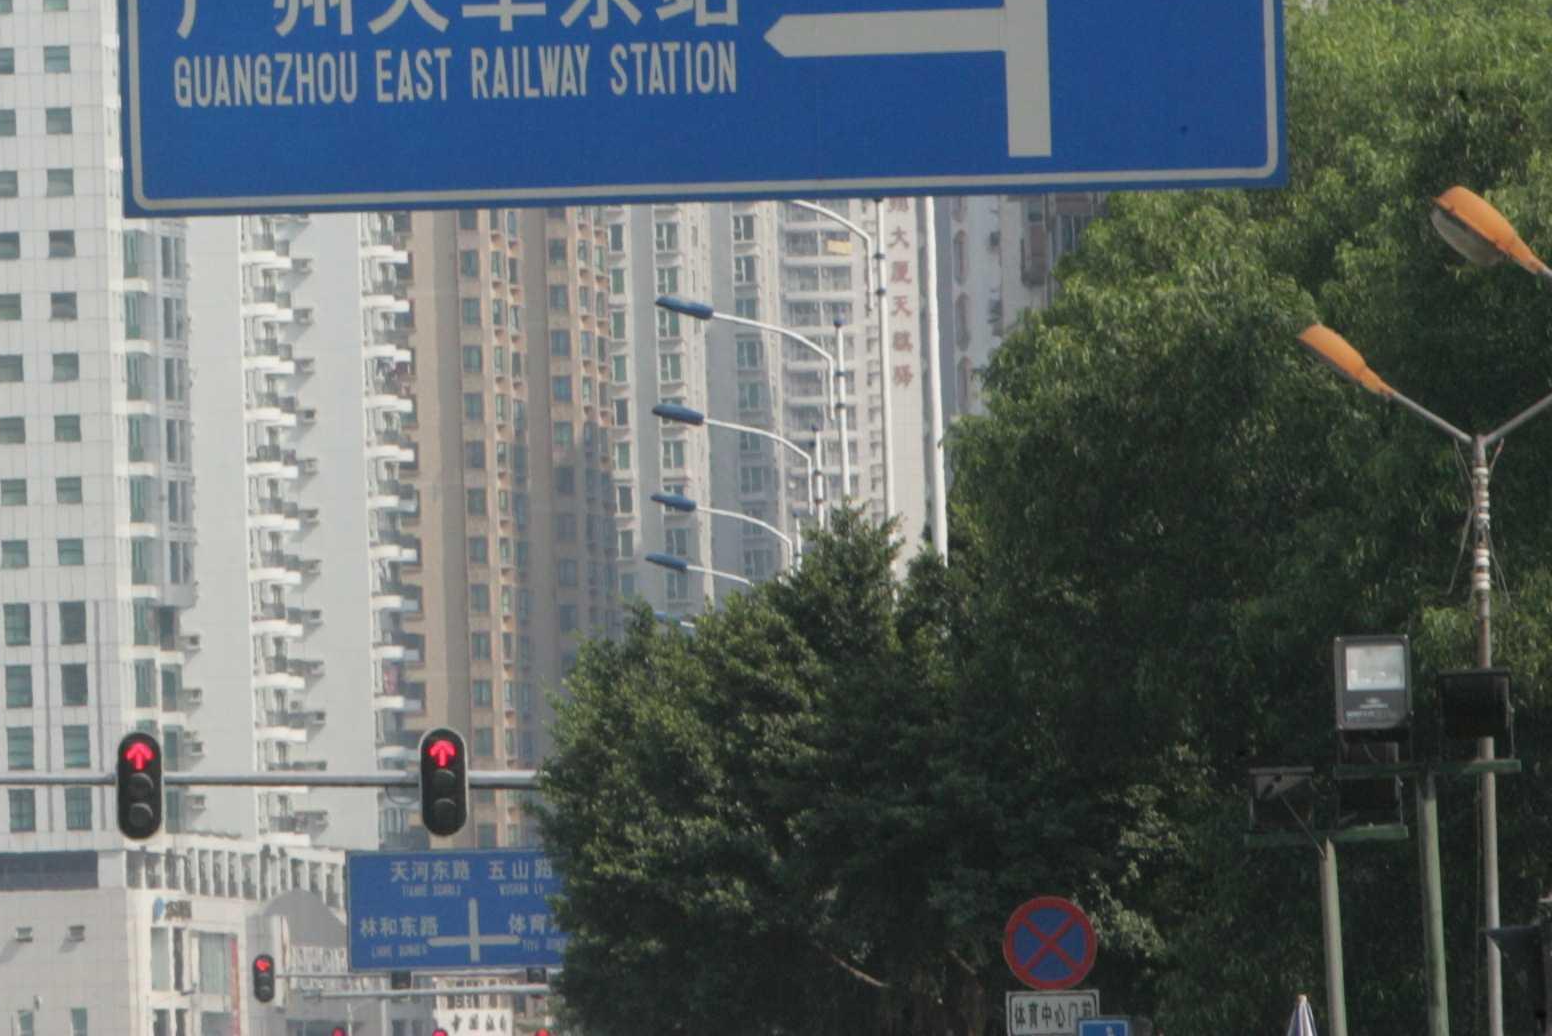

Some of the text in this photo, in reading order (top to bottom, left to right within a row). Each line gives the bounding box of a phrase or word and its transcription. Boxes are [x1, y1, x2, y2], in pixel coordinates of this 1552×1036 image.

[174, 41, 737, 108] GUANGZHOU EAST RAILWAY STATION
[392, 859, 469, 881] 天河东路
[490, 858, 552, 880] 五山路
[361, 916, 438, 937] 林和东路
